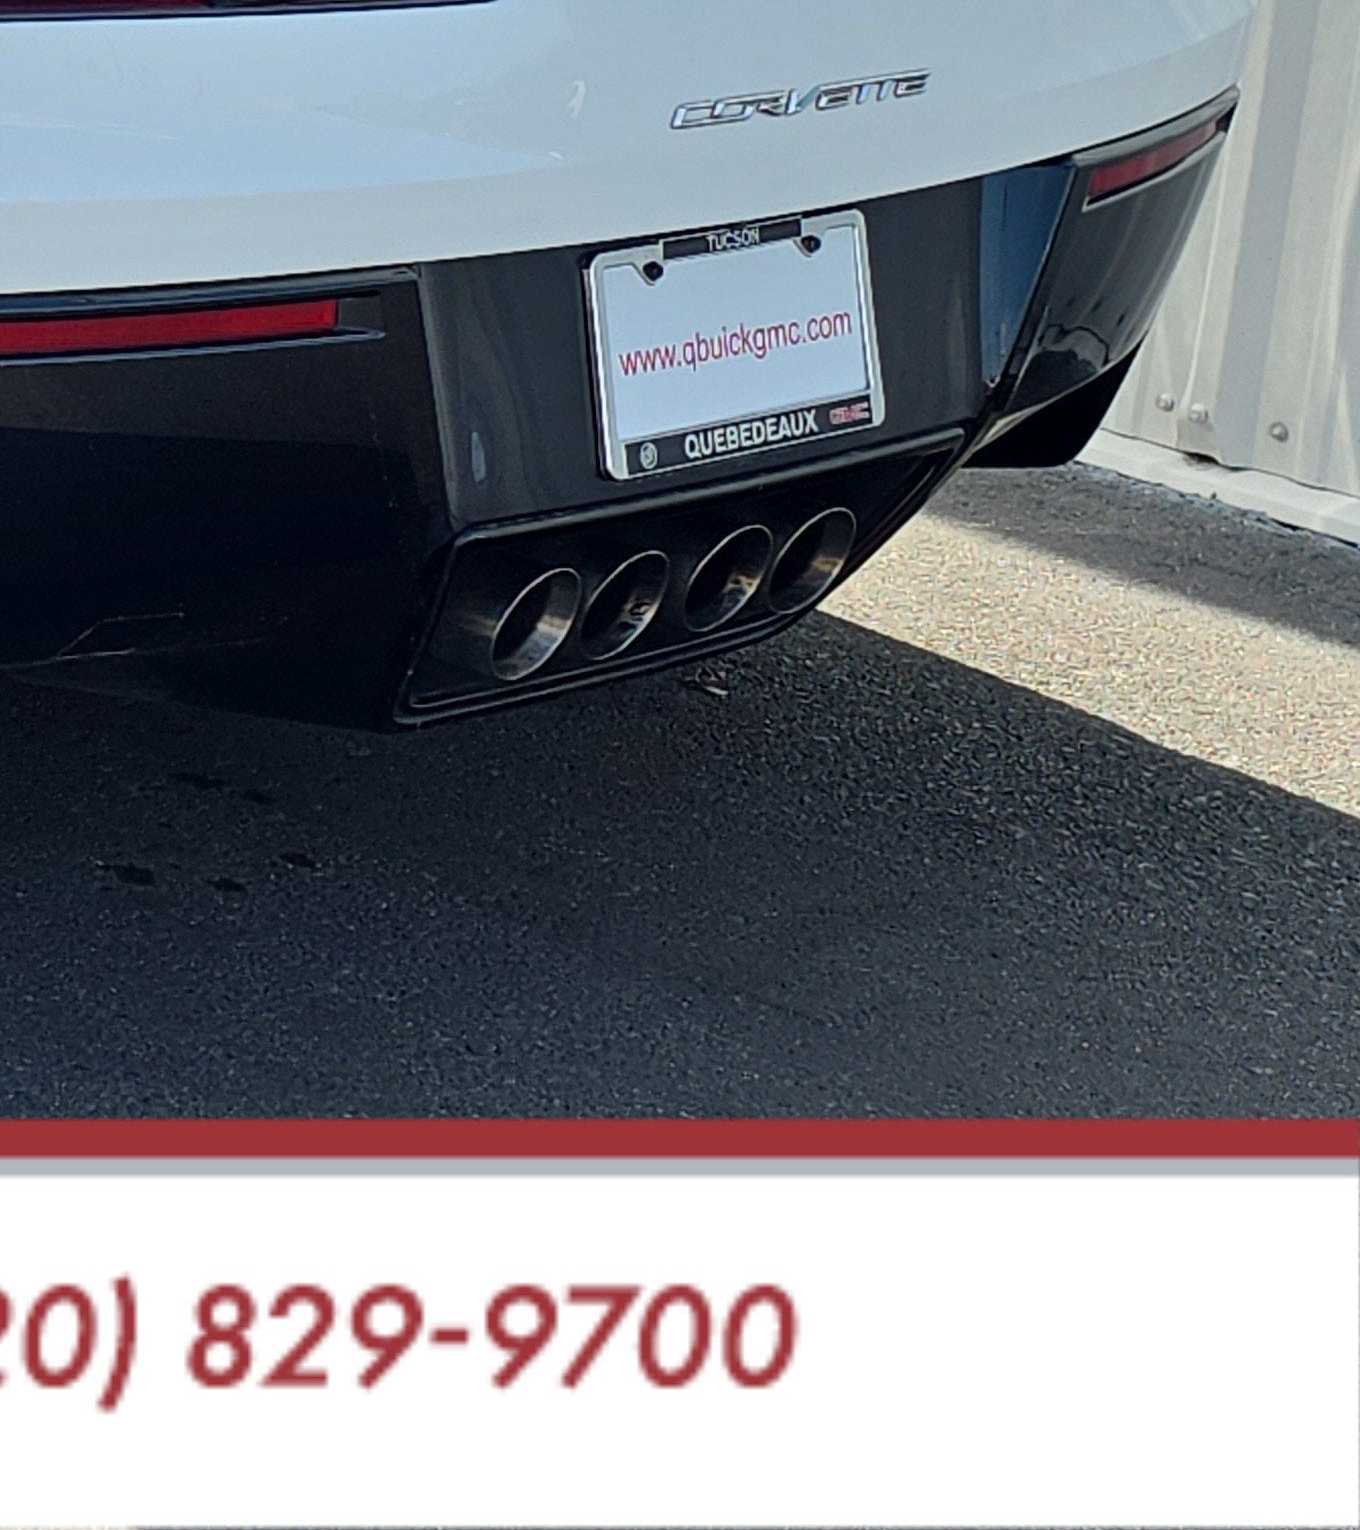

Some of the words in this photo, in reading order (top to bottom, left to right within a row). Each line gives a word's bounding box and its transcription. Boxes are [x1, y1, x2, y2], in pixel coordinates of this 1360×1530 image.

[670, 67, 932, 130] CORVETTE
[705, 227, 760, 253] TUCSON
[618, 310, 853, 377] www.qbuickgmc.com
[683, 408, 820, 460] QUEBEDEAUX
